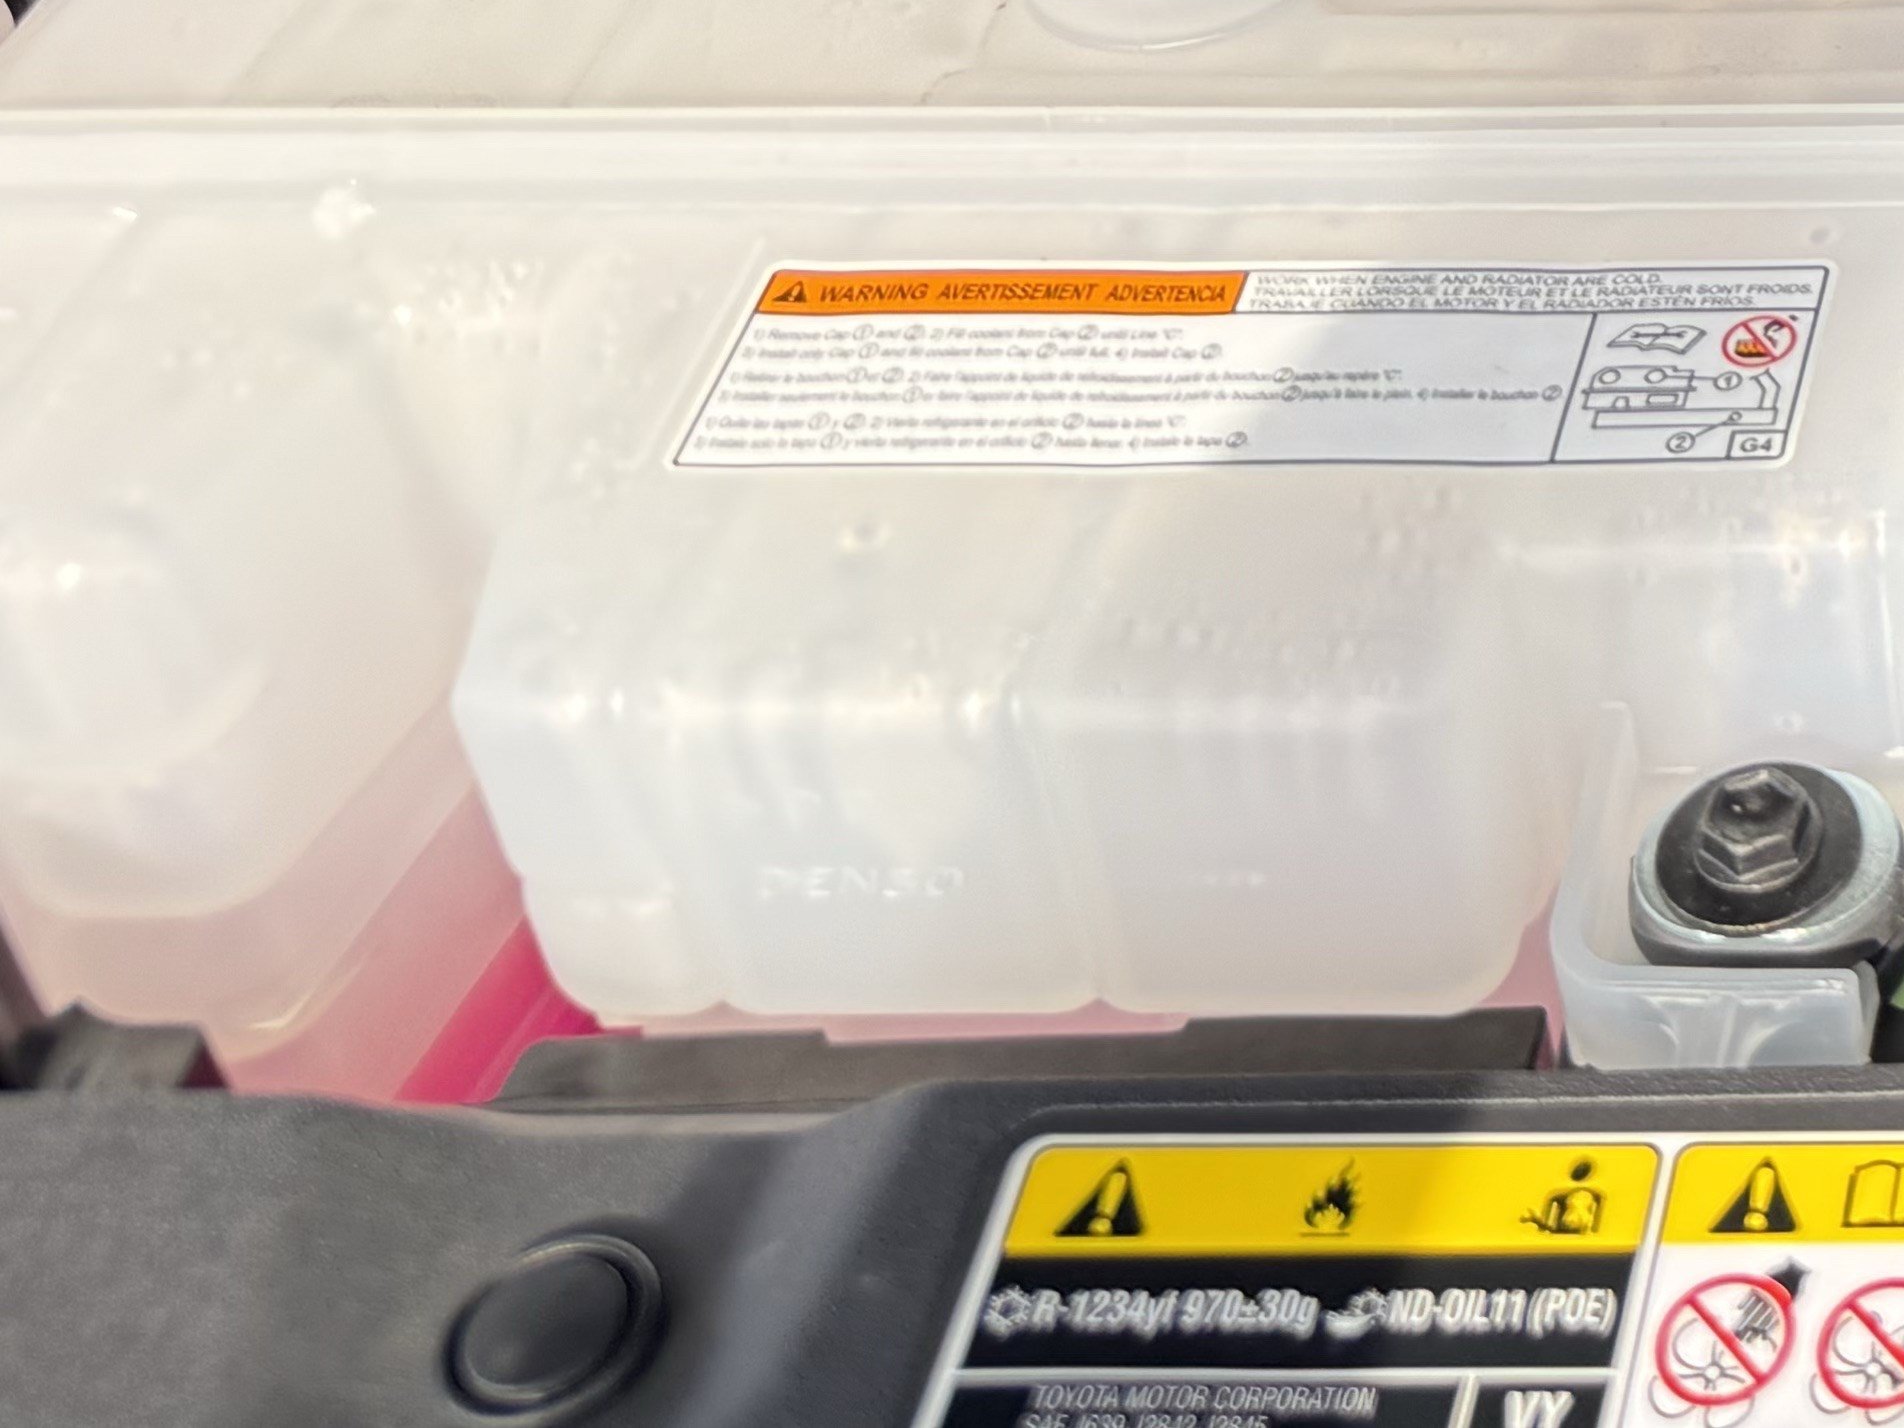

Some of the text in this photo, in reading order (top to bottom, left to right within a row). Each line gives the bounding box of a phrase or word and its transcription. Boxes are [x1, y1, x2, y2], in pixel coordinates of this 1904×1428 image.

[1440, 274, 1478, 285] AND
[1481, 274, 1569, 286] RADIATOR
[1571, 275, 1607, 286] ARE
[818, 282, 1227, 303] WARNING AVERTISSEMENT ADVERTENCIA
[1596, 285, 1692, 296] RADIATEUR
[1696, 284, 1742, 295] SONT
[1433, 298, 1497, 309] MOTOR
[1542, 298, 1634, 309] RADIADOR
[1739, 437, 1773, 453] G4
[1387, 1288, 1528, 1336] ND-OIL11
[1528, 1287, 1618, 1340] (POE)
[1035, 1384, 1378, 1414] TOYOTA MOTOR CORPORATION
[1503, 1390, 1576, 1428] VY
